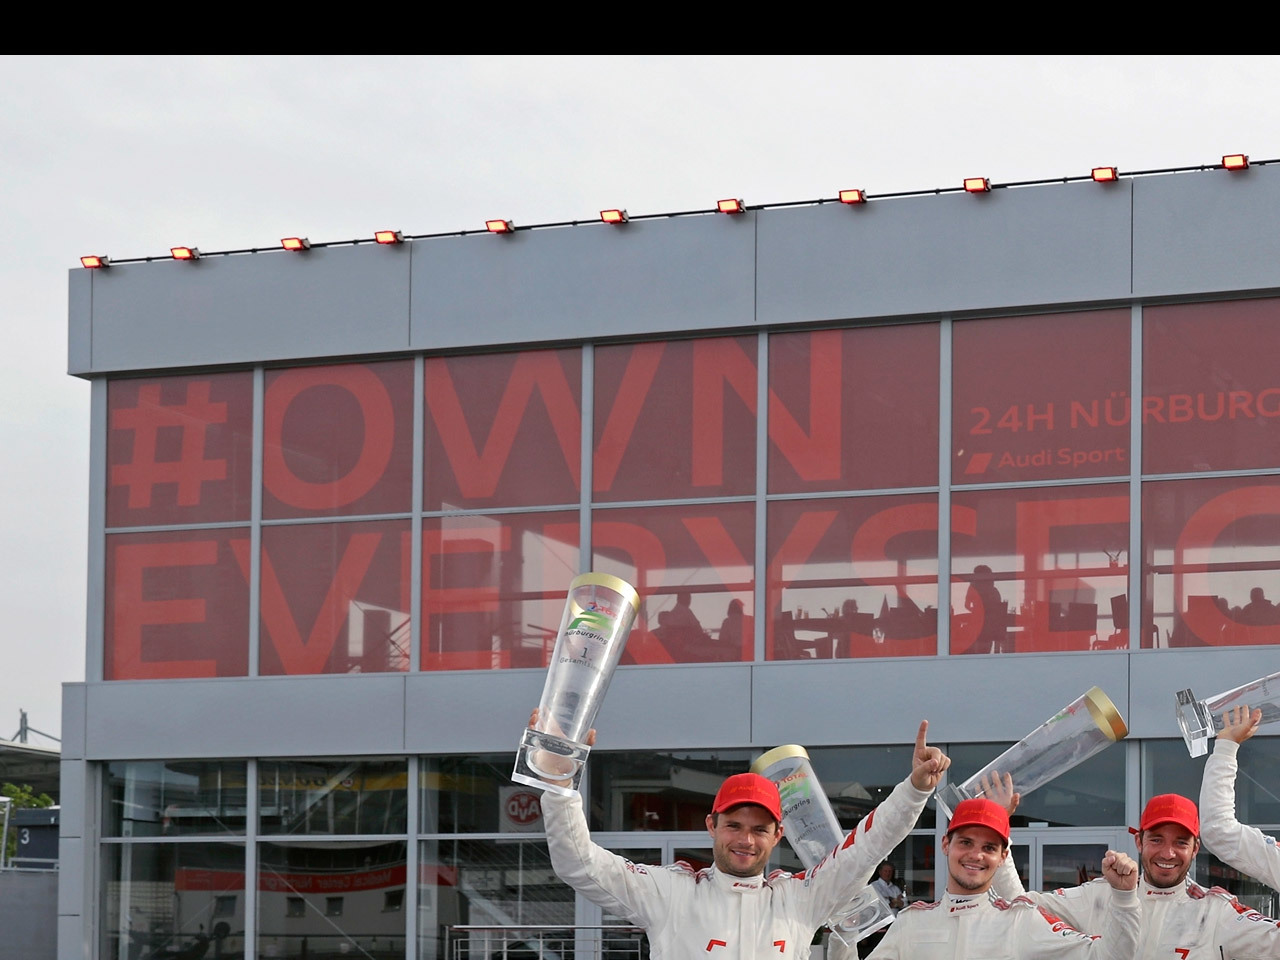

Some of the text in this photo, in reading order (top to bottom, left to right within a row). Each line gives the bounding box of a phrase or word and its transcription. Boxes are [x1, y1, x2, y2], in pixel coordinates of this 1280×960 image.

[111, 330, 843, 510] #OWN
[970, 402, 1055, 435] 24H
[998, 447, 1126, 468] Audi Sport
[20, 828, 30, 845] 3
